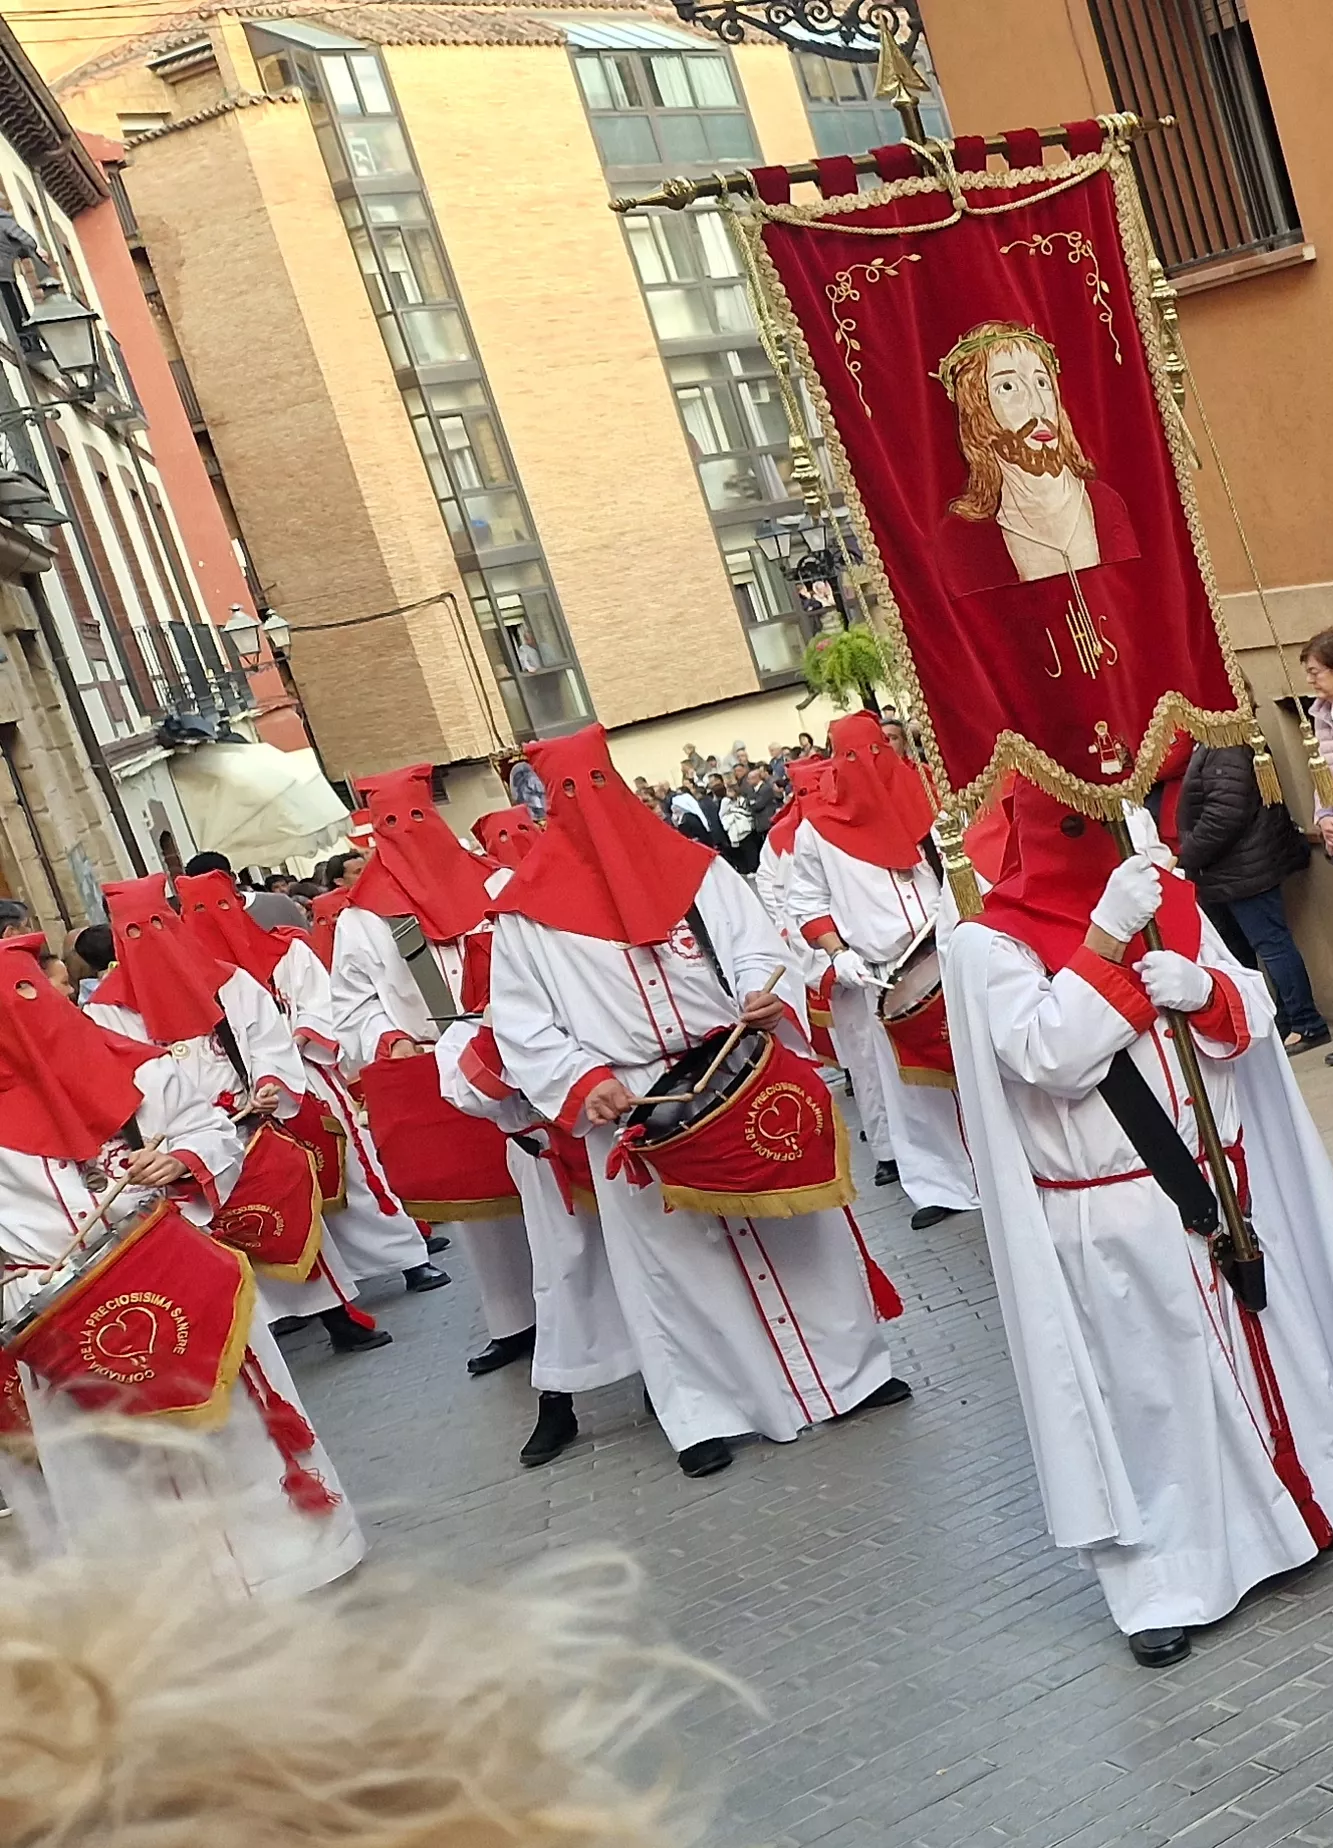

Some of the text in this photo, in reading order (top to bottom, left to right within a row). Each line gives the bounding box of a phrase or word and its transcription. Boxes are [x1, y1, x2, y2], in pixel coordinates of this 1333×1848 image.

[744, 1110, 760, 1125] LA
[745, 1126, 756, 1141] DE
[85, 1291, 174, 1328] PRECIOSISIMA
[79, 1329, 94, 1345] LA
[170, 1307, 190, 1356] SANGRE
[81, 1346, 96, 1361] DE
